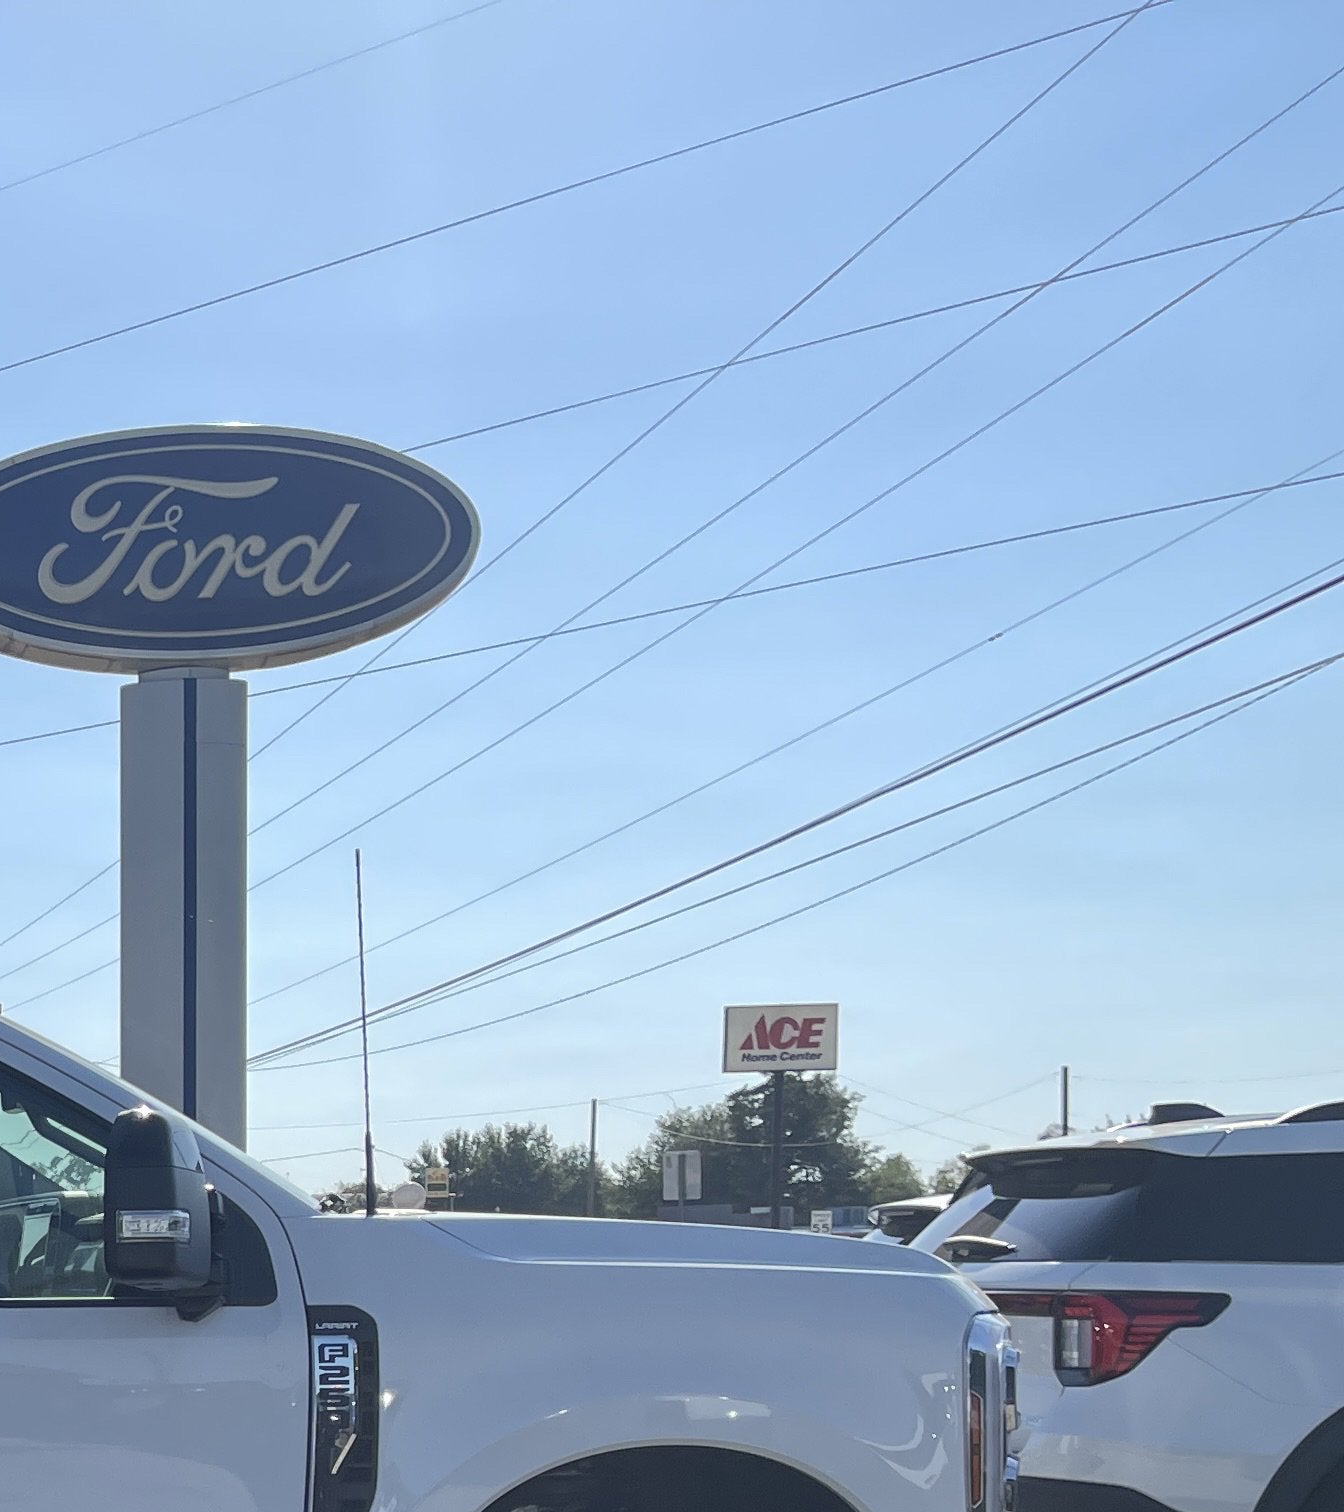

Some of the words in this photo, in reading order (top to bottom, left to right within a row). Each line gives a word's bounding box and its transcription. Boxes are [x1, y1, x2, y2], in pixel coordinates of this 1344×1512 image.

[37, 474, 360, 604] Ford
[739, 1013, 826, 1050] ACE
[741, 1052, 777, 1062] Home
[779, 1051, 823, 1061] Center
